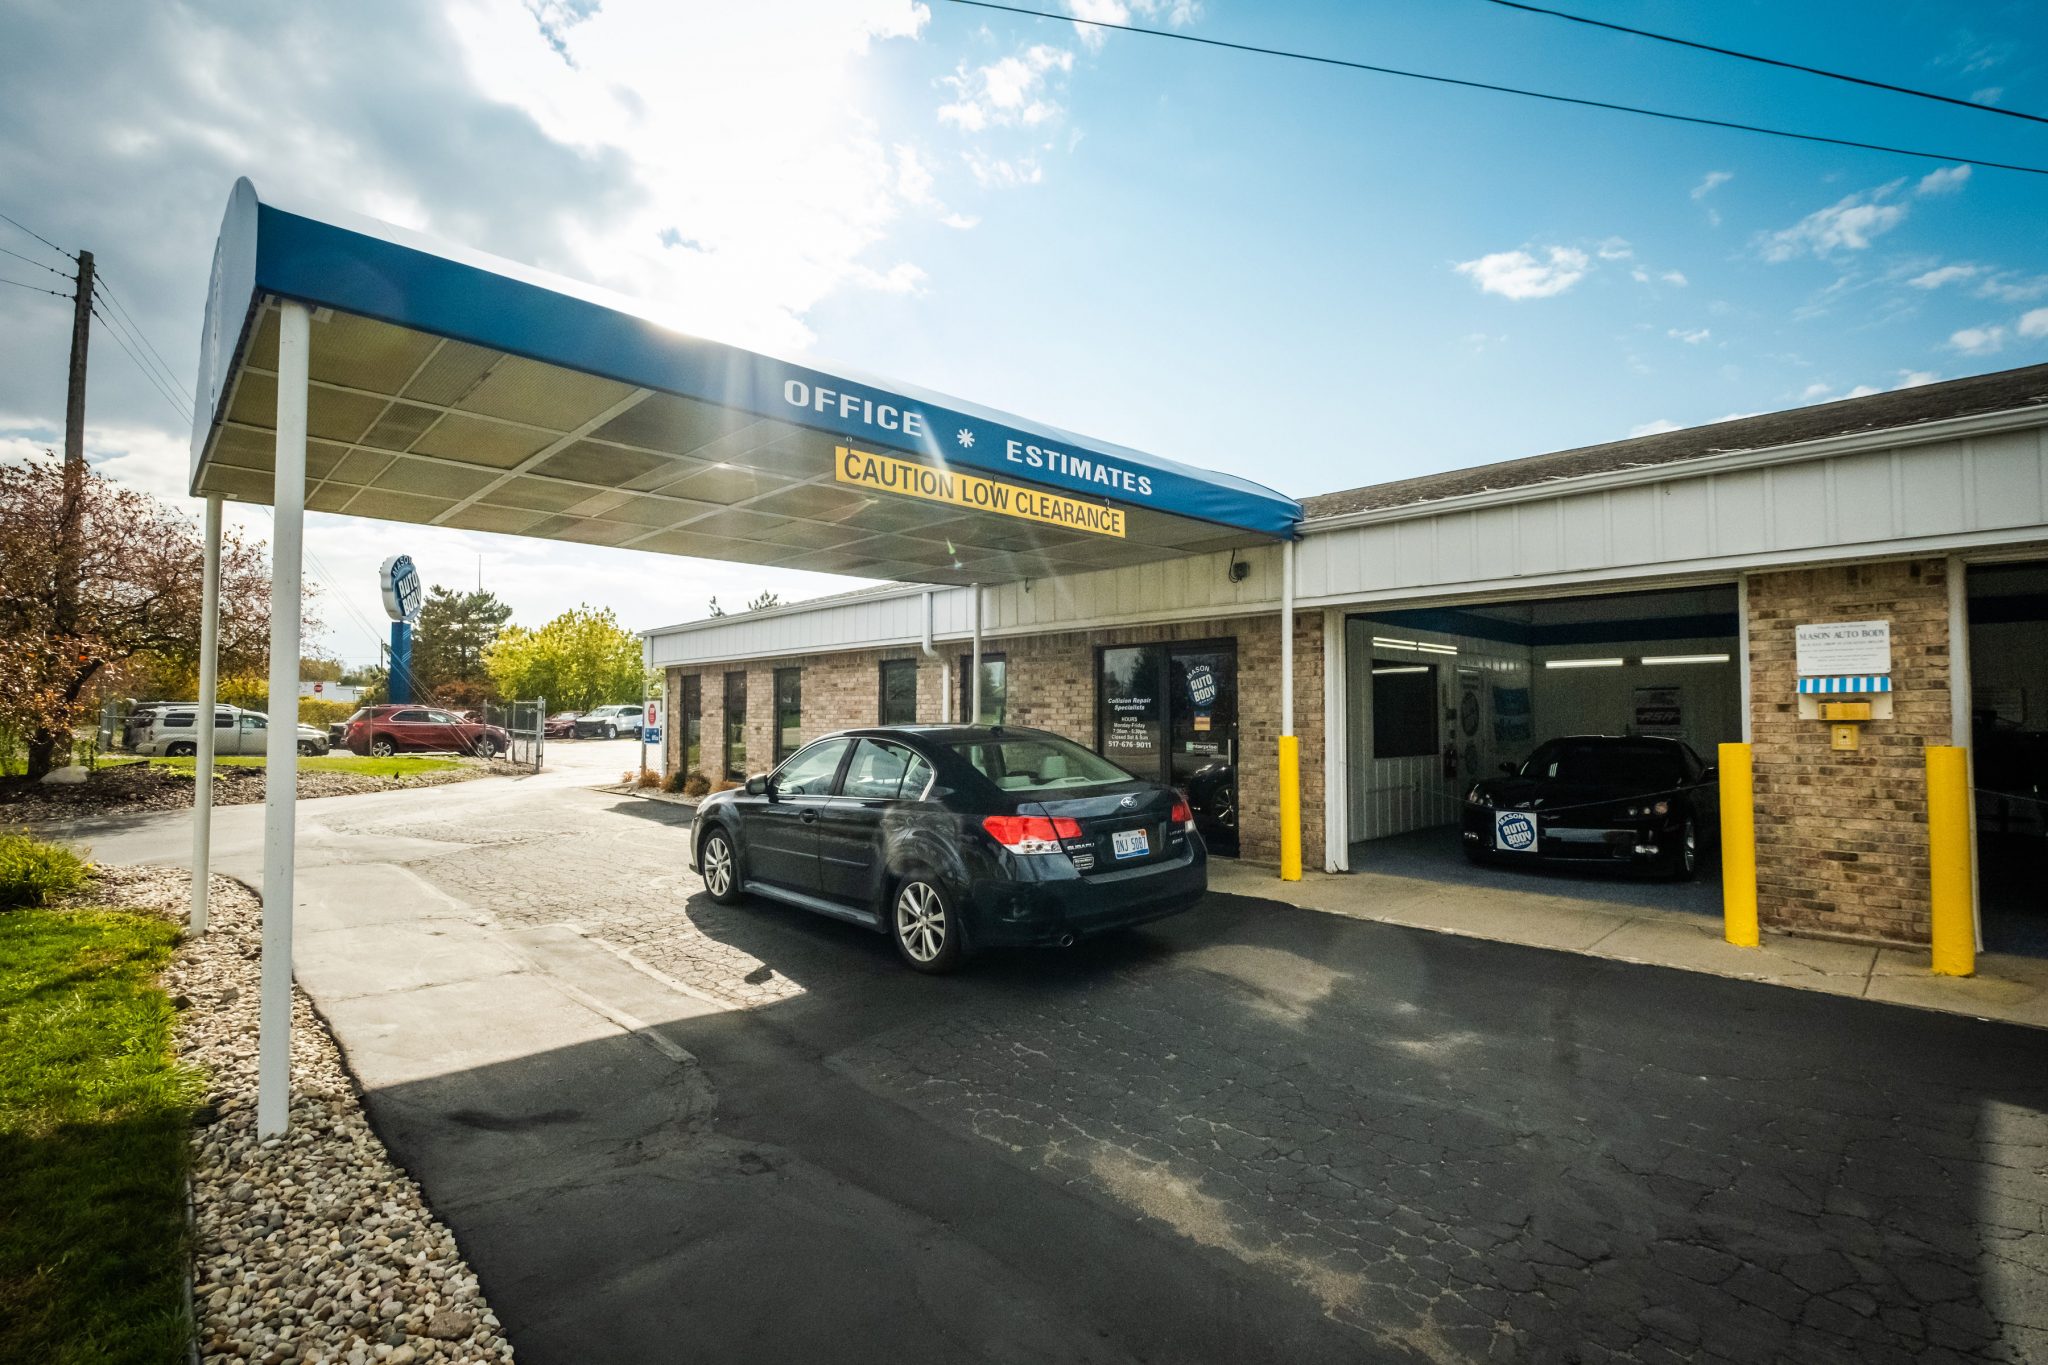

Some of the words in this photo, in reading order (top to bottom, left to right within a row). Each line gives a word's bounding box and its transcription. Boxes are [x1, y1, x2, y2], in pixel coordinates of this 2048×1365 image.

[784, 379, 922, 438] OFFICE
[1006, 439, 1152, 495] ESTIMATES
[844, 452, 954, 500] CAUTION
[961, 479, 1009, 510] LOW
[1015, 492, 1121, 534] CLEARANCE
[398, 570, 418, 599] AUTO
[402, 587, 421, 616] BODY
[1799, 632, 1830, 640] MASON
[1833, 630, 1859, 639] AUTO
[1862, 629, 1885, 638] BODY
[1186, 665, 1210, 680] MASON
[1190, 674, 1213, 692] AUTO
[1132, 697, 1152, 705] Repair
[1193, 685, 1215, 703] BODY
[1108, 740, 1152, 749] 517-676-9011
[1498, 813, 1524, 826] MASON
[1502, 821, 1529, 836] AUTO
[1506, 831, 1532, 845] BODY
[1066, 842, 1095, 851] SUBARU
